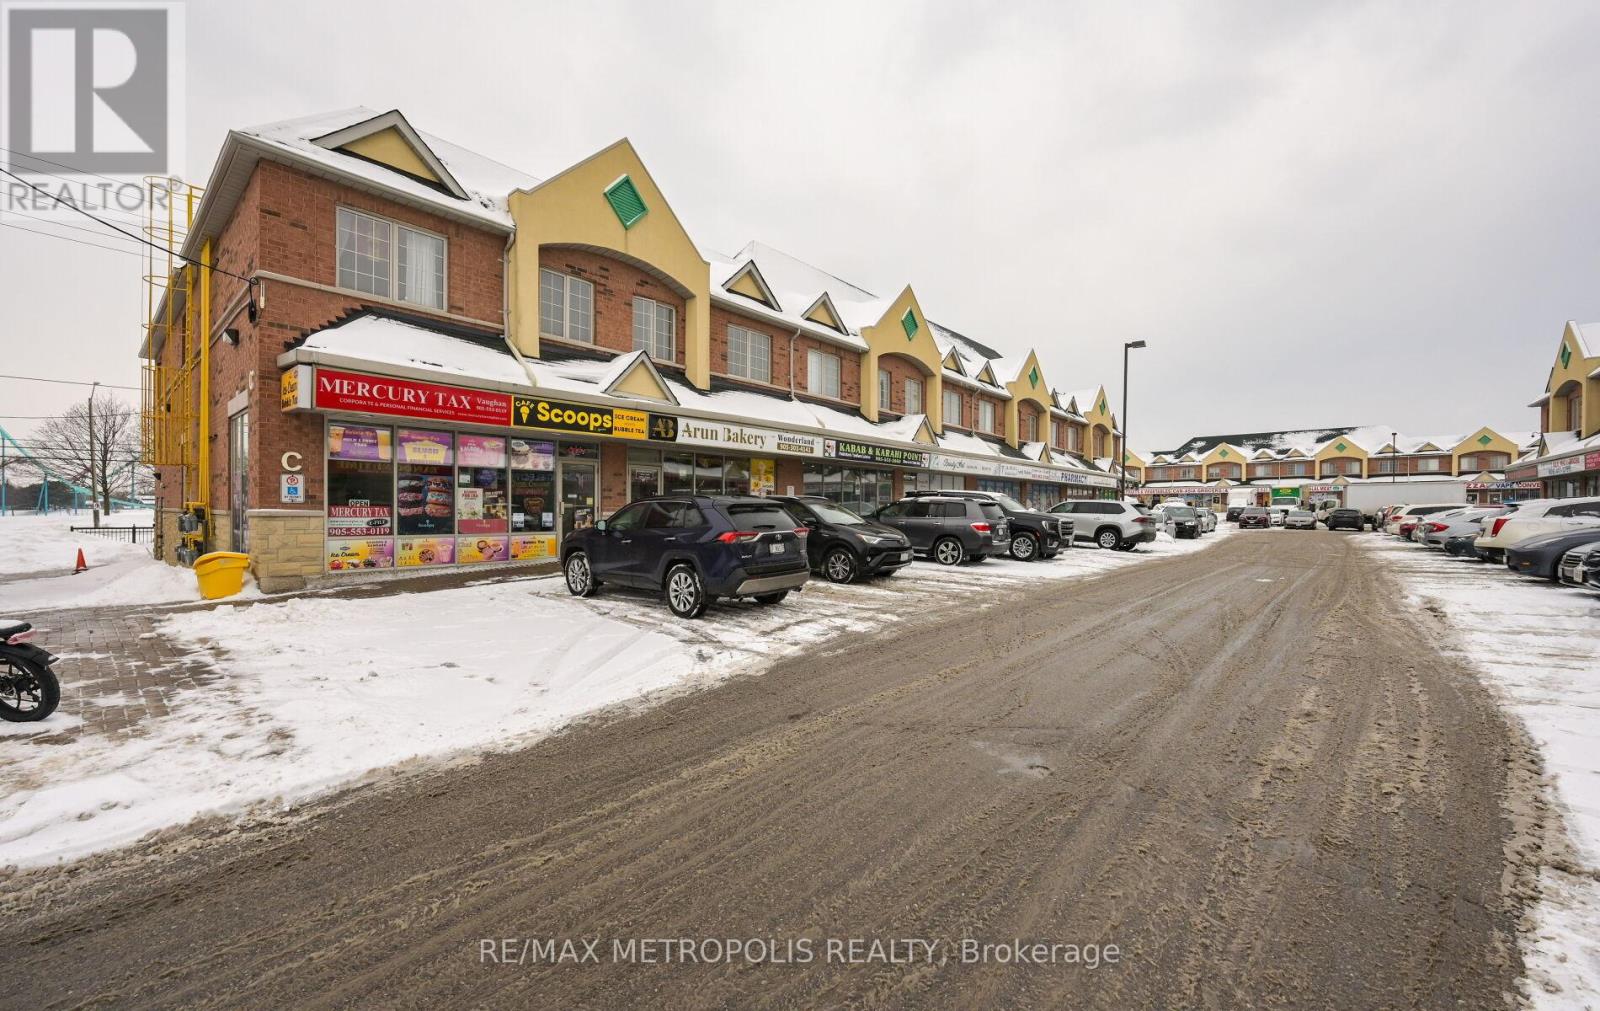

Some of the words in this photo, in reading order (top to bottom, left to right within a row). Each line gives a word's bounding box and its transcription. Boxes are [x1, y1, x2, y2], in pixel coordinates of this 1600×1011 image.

[319, 376, 429, 405] MERCURY
[434, 391, 472, 410] TAX
[380, 401, 405, 411] PERSONAL
[406, 405, 433, 414] FINANCIAL
[433, 408, 456, 416] SERVICES
[476, 397, 507, 408] Vaughan
[537, 401, 613, 431] Scoops
[625, 415, 645, 423] CREAM
[613, 425, 633, 433] BUBBLE
[682, 423, 718, 441] Arun
[723, 427, 767, 449] Bakery
[777, 434, 815, 446] Wonderland
[839, 442, 866, 455] KABAB
[867, 446, 874, 456] &
[875, 447, 902, 460] KARAHI
[903, 452, 922, 463] POINT
[281, 451, 302, 472] C
[331, 507, 373, 518] MERCURY
[375, 507, 389, 517] TAX
[329, 528, 390, 536] 905-553-0119
